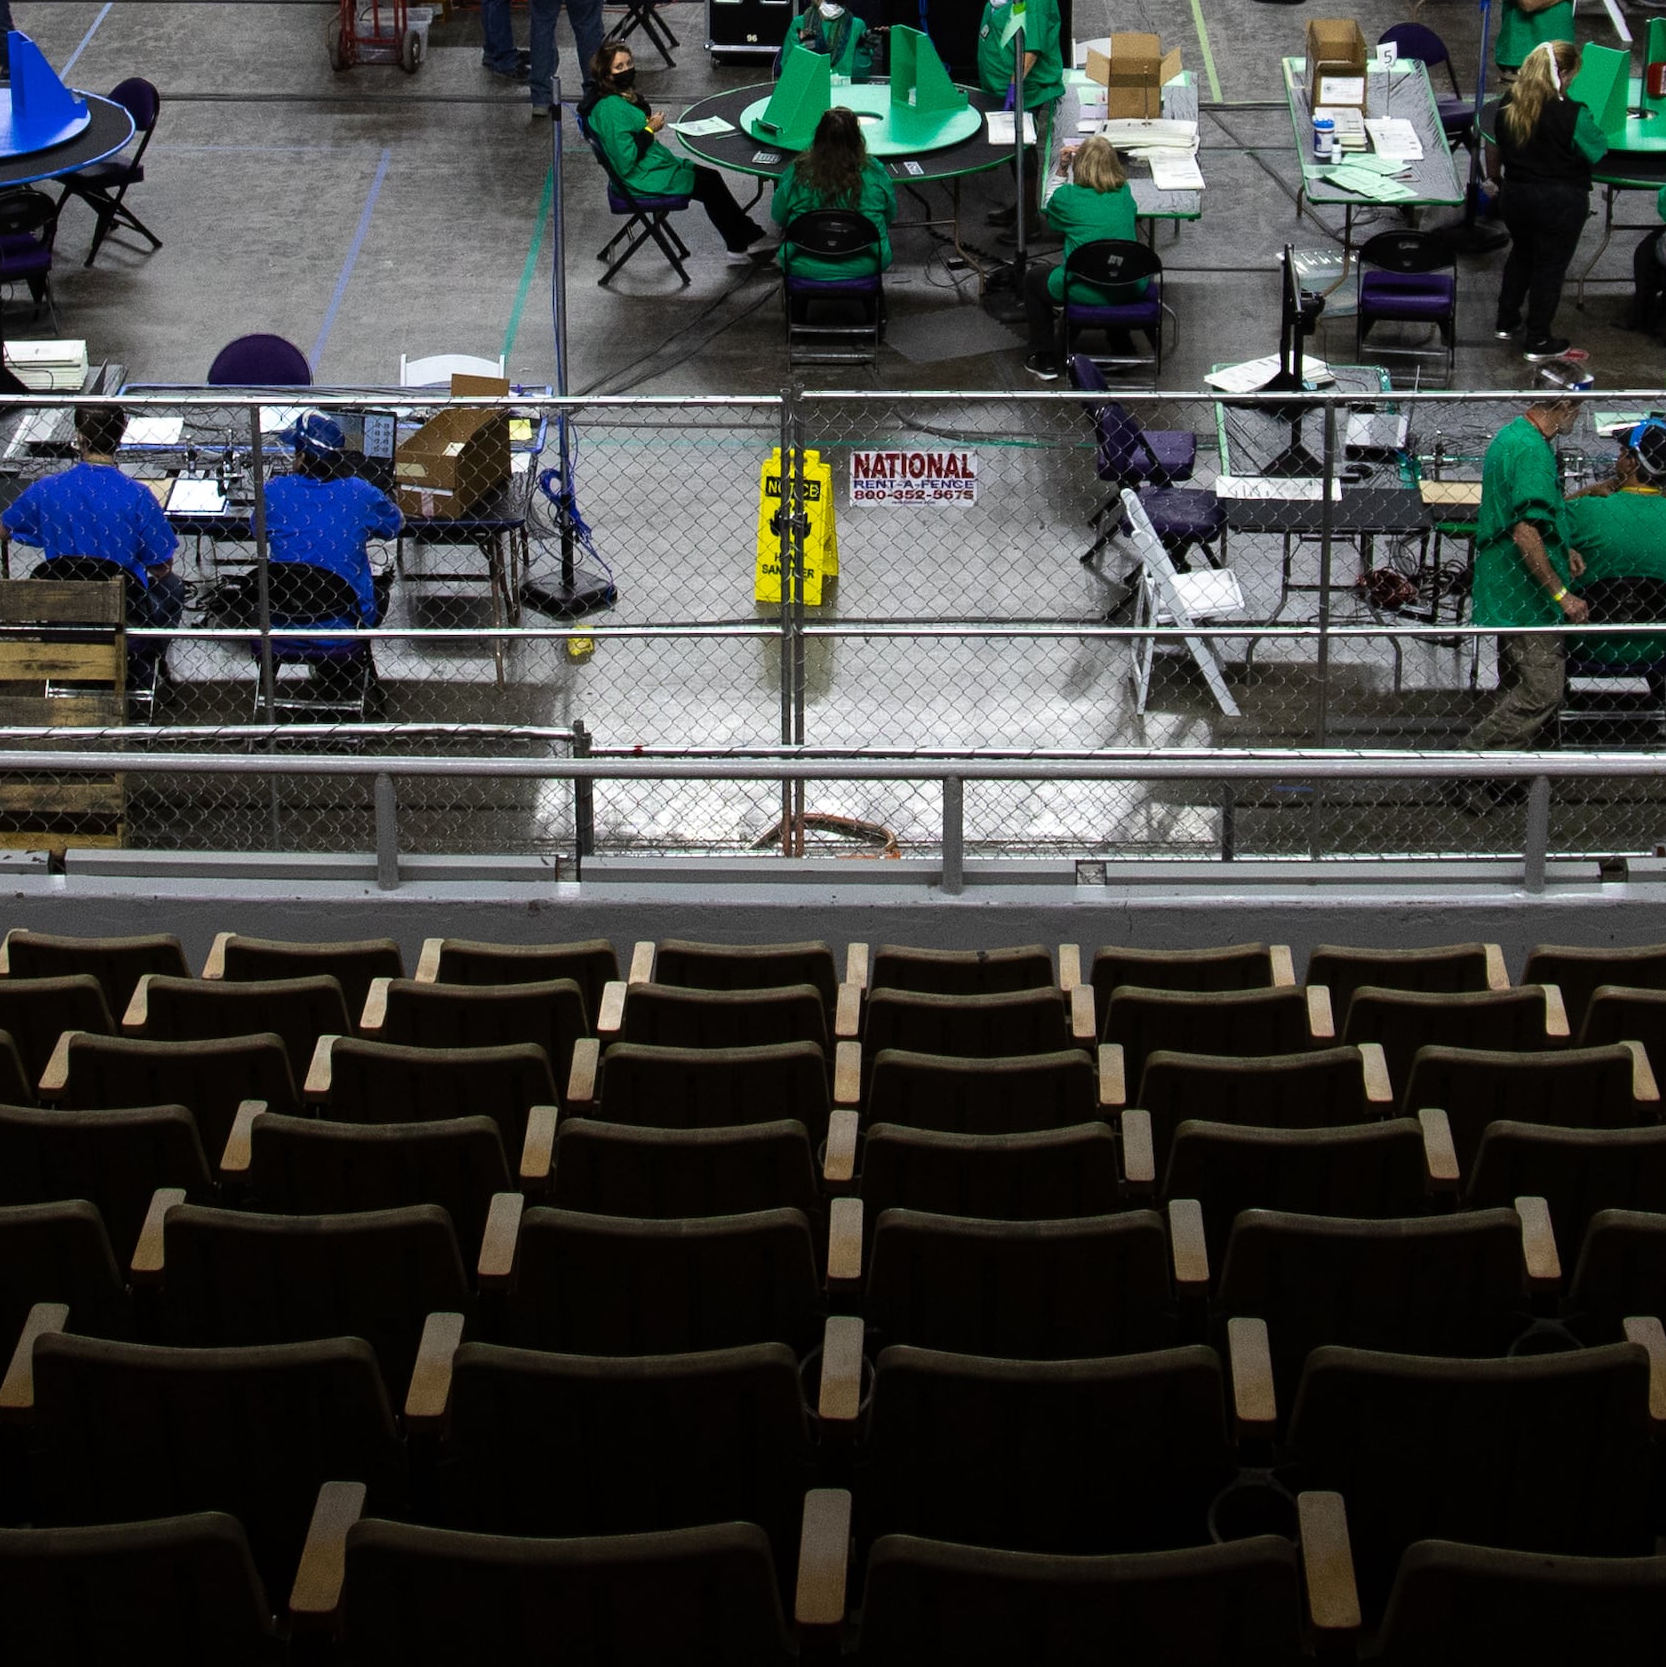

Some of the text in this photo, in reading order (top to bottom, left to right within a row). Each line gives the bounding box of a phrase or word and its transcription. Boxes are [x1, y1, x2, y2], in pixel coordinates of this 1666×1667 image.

[1384, 49, 1392, 65] 5
[854, 452, 975, 480] NATIONAL
[853, 479, 974, 489] RENT-A-FENCE
[854, 490, 974, 500] 800-352-5675
